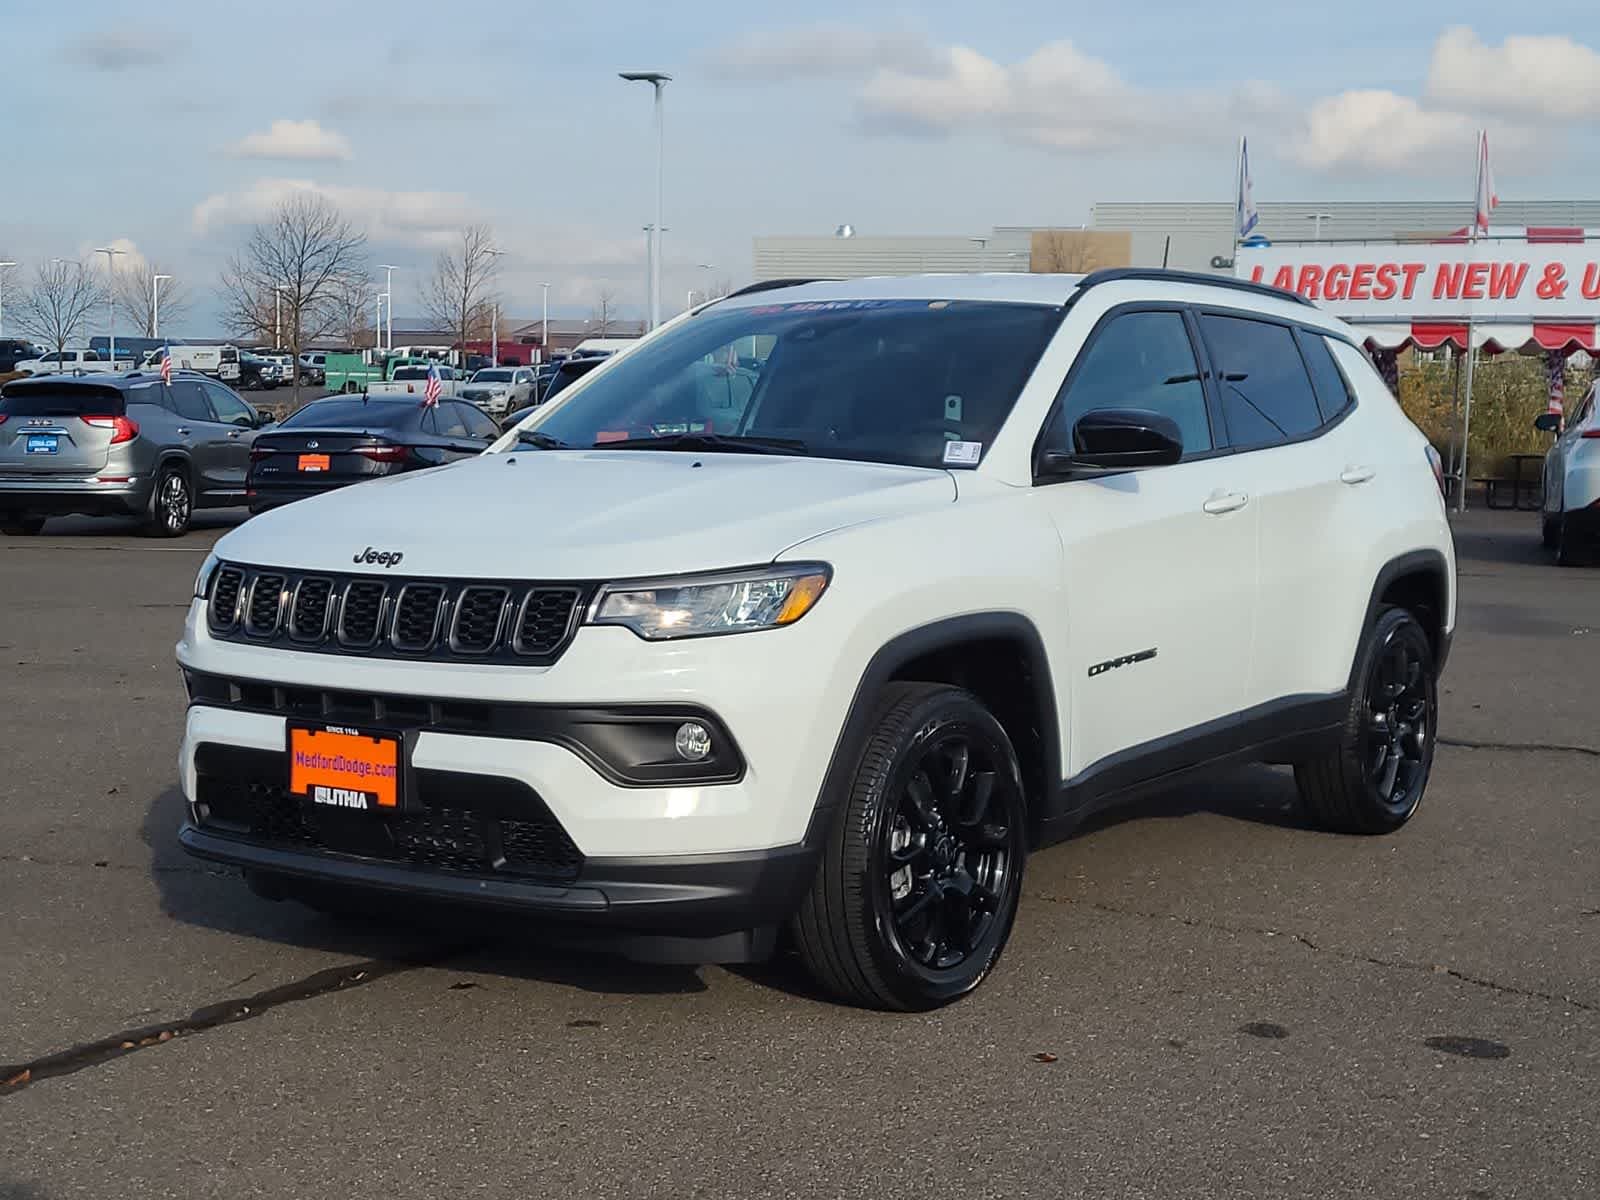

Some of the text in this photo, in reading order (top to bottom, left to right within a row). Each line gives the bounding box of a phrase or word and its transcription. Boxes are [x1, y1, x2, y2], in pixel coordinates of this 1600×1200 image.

[1431, 262, 1530, 300] NEW
[1536, 262, 1569, 300] &
[353, 547, 403, 568] Jeep
[296, 752, 397, 779] MedfordDodge.com
[326, 787, 368, 810] LITHIA
